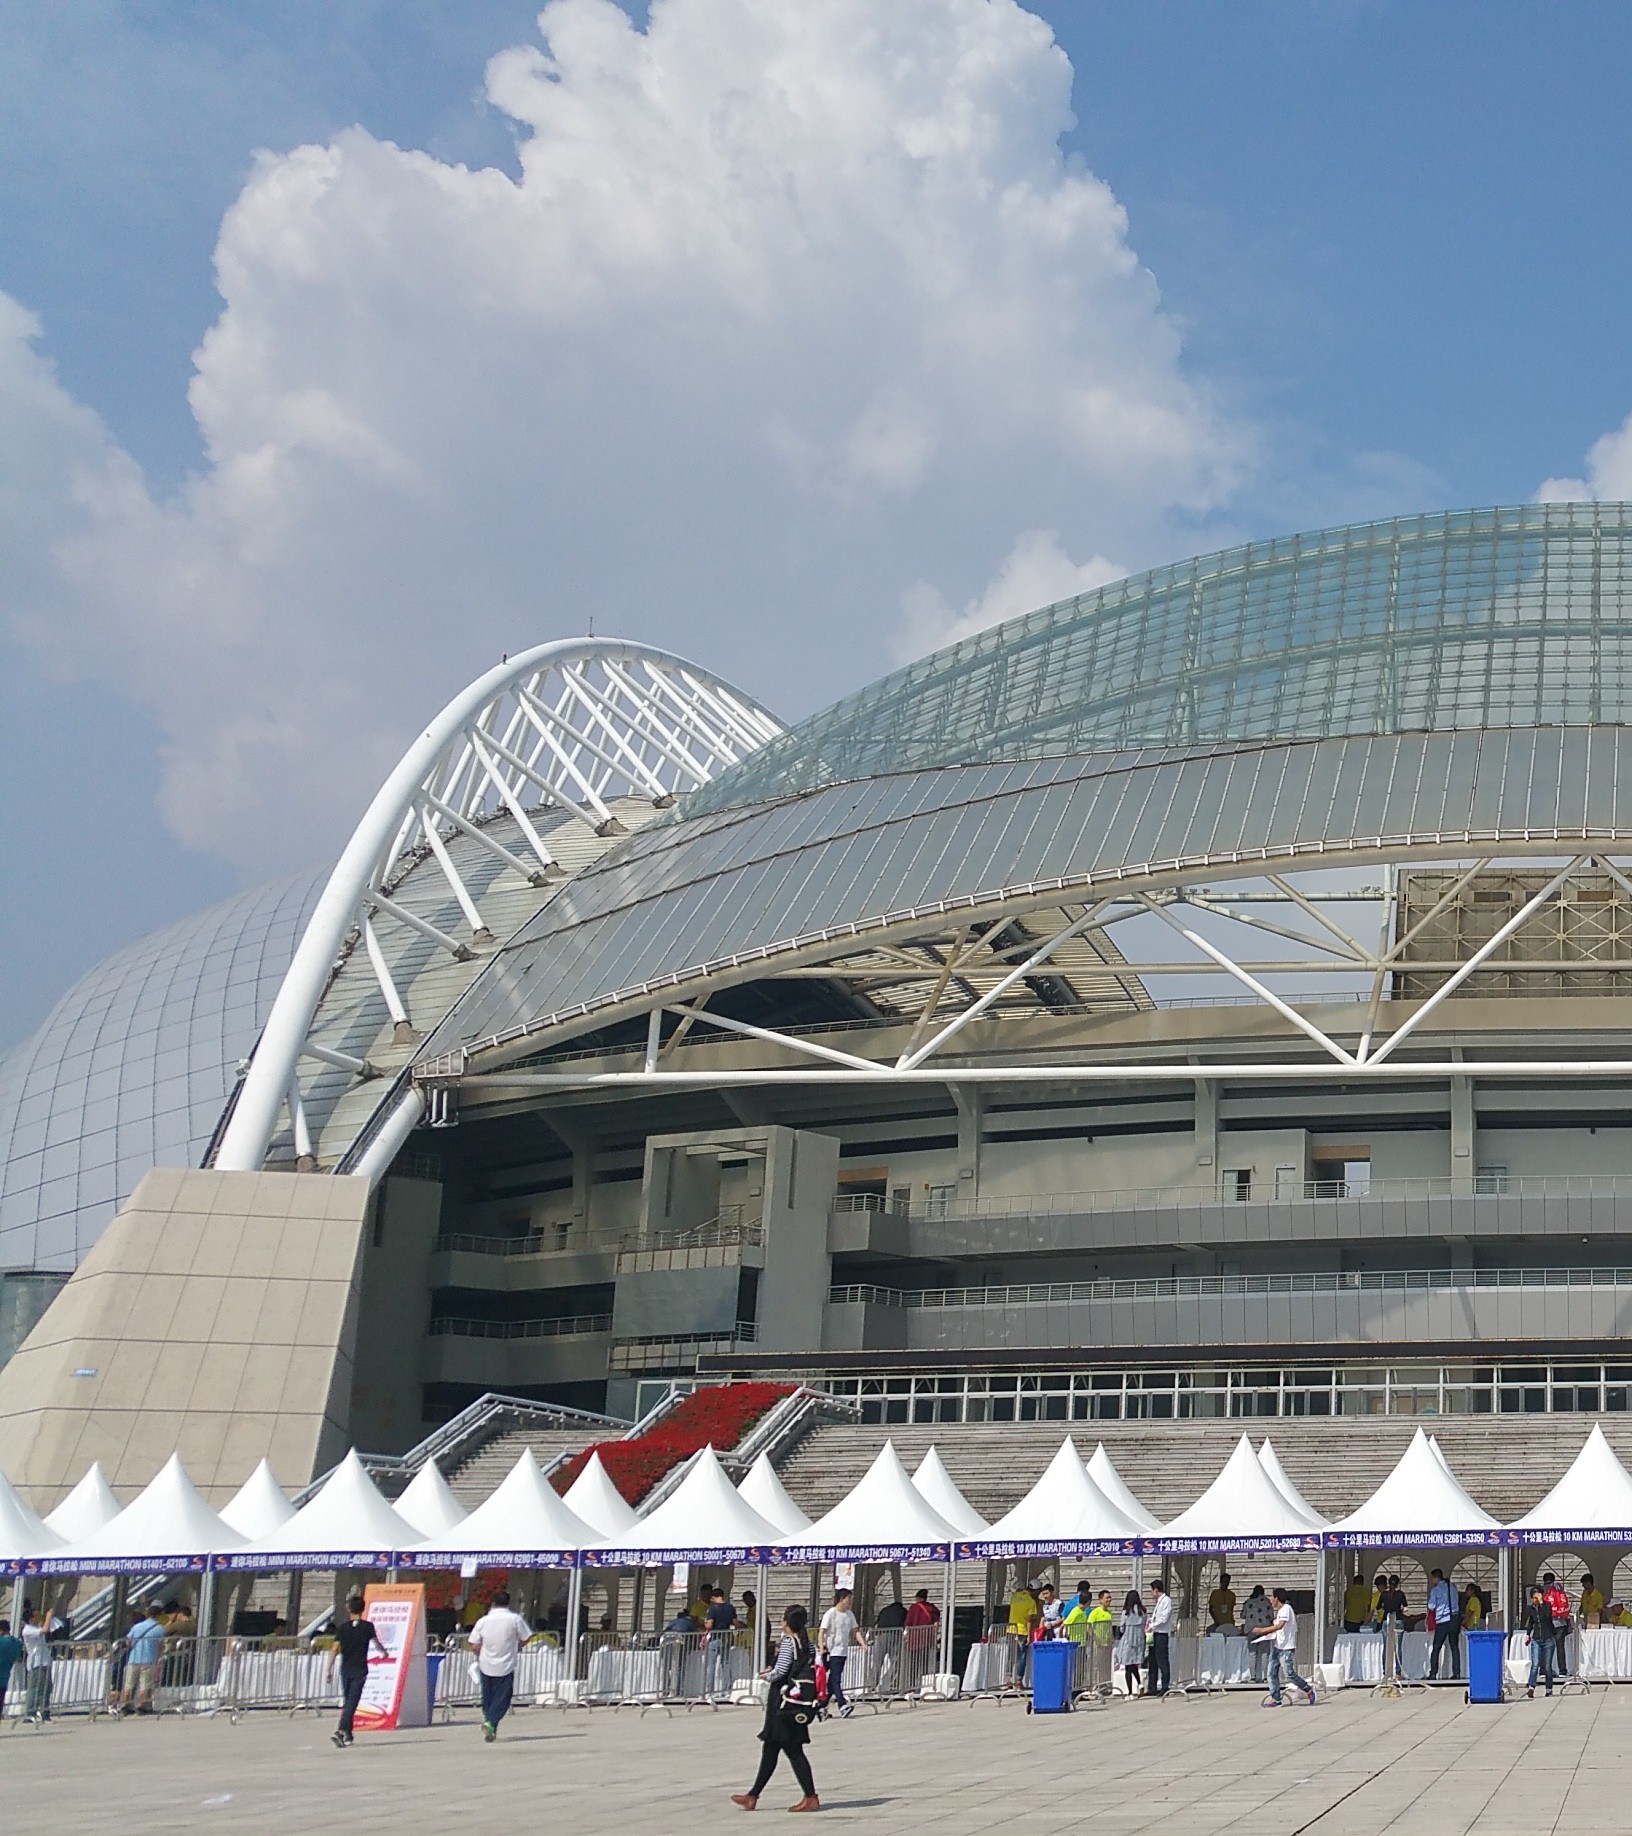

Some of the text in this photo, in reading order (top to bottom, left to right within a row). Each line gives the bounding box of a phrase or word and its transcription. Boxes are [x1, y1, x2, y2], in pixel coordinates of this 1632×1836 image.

[1342, 1534, 1382, 1546] 十公里马拉松
[1383, 1534, 1391, 1544] 10
[1392, 1534, 1404, 1544] KM
[1404, 1533, 1444, 1544] MARATHON
[1522, 1531, 1562, 1543] 十公里马拉松
[1563, 1531, 1571, 1541] 10
[1572, 1531, 1583, 1541] KM
[1584, 1531, 1624, 1541] MARATHON
[975, 1543, 1015, 1556] 十公里马拉松
[1016, 1543, 1024, 1554] 10
[1025, 1543, 1037, 1554] KM
[1037, 1542, 1078, 1554] MARATHON
[1158, 1540, 1197, 1552] 十公里马拉松
[1199, 1540, 1207, 1550] 10
[1207, 1539, 1219, 1550] KM
[1220, 1538, 1260, 1550] MARATHON
[452, 1554, 468, 1565] MIN
[642, 1552, 650, 1562] 10
[651, 1551, 662, 1562] KM
[663, 1550, 703, 1561] MARATHON
[827, 1548, 835, 1559] 10
[836, 1548, 848, 1559] KM
[848, 1548, 889, 1558] MARATHON
[79, 1560, 96, 1571] MINI
[97, 1559, 141, 1571] MARATHON
[268, 1555, 285, 1566] MINI
[286, 1554, 328, 1565] MARATHON
